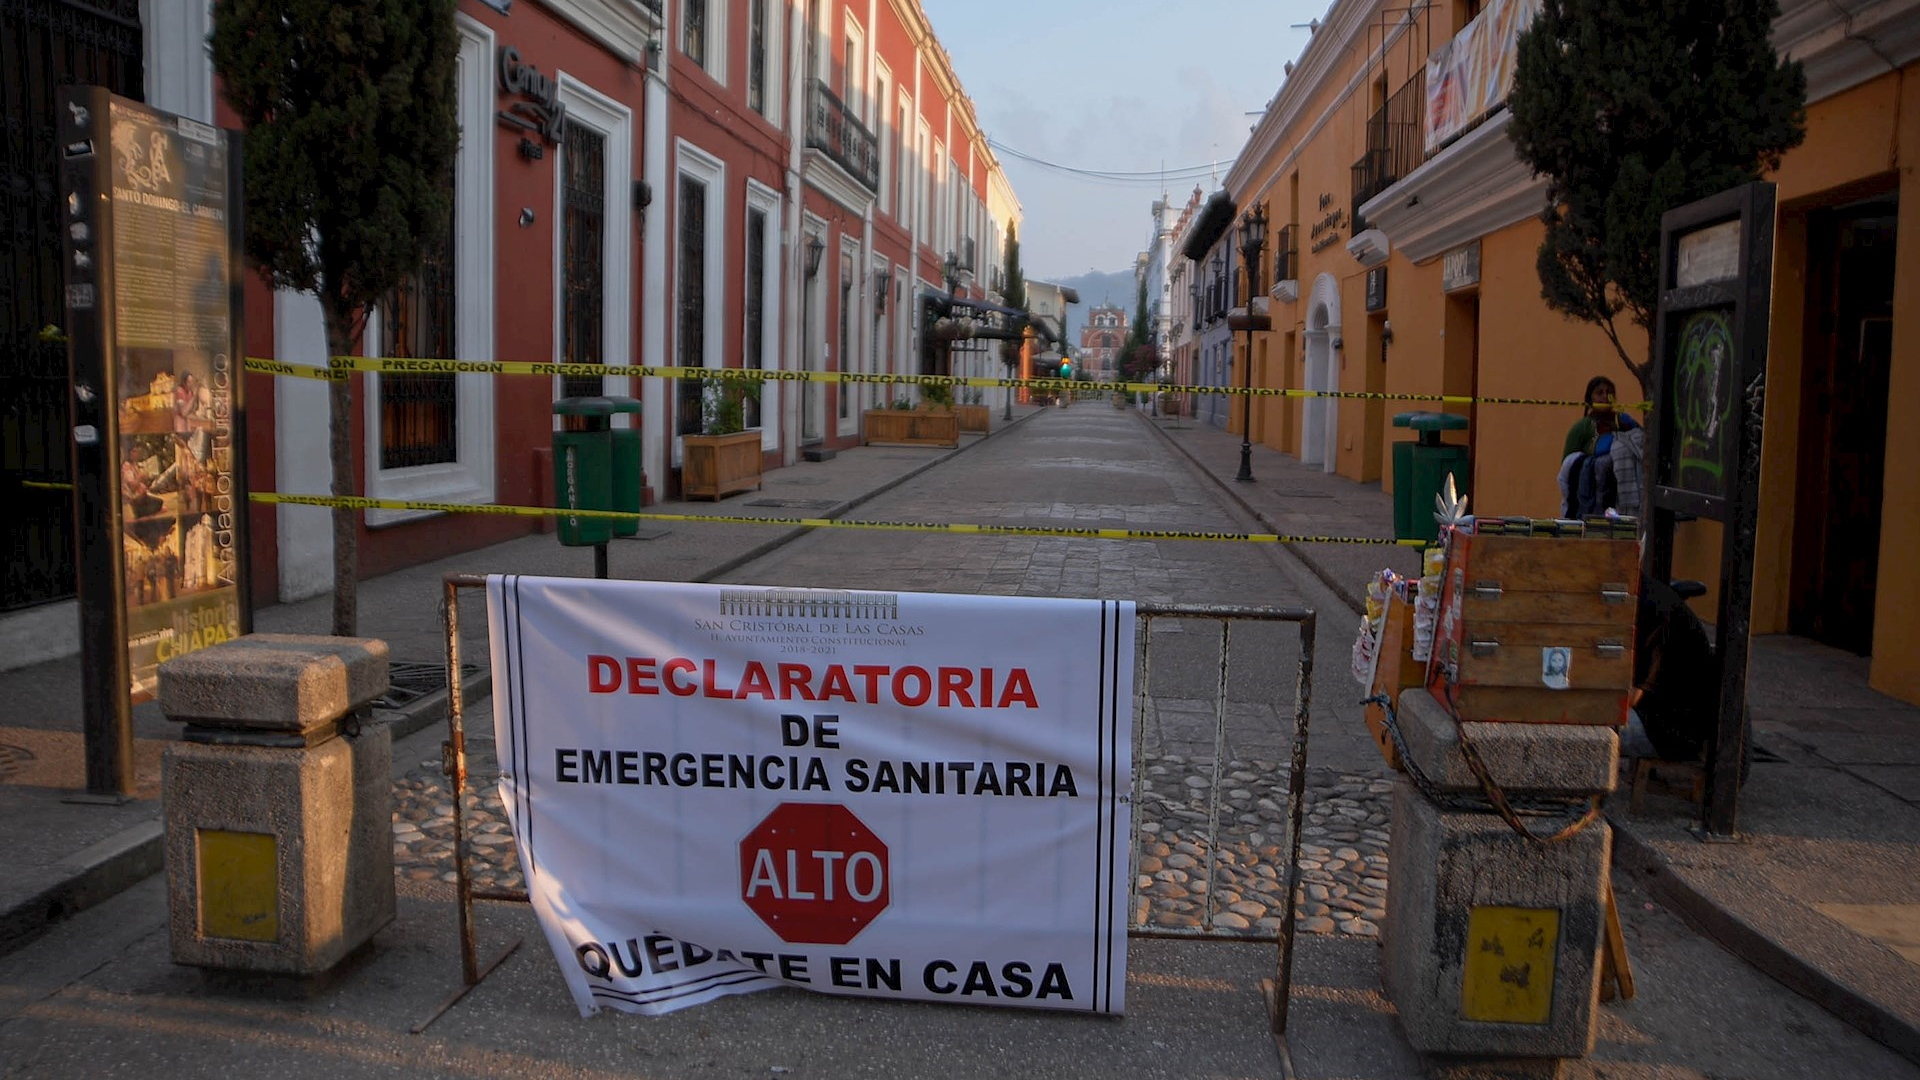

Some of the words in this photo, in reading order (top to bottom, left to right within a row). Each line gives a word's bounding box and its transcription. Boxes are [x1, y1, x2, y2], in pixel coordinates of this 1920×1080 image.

[113, 186, 141, 204] SANTO
[213, 468, 236, 585] Andador
[172, 599, 238, 633] historia
[694, 619, 724, 631] SAN
[729, 618, 813, 633] CRISTÓBAL
[818, 623, 839, 633] DE
[845, 622, 871, 634] LAS
[876, 623, 925, 636] CASAS
[156, 620, 238, 663] CHIAPAS
[725, 634, 809, 643] AYUNTAMIENTO
[811, 635, 907, 646] CONSTITUCIONAL
[780, 645, 837, 654] 2018-2021
[586, 654, 1040, 709] DECLARATORIA
[780, 713, 841, 750] DE
[555, 748, 831, 793] EMERGENCIA
[844, 757, 1079, 798] SANITARIA
[745, 848, 884, 903] ALTO
[828, 955, 902, 991] EN
[923, 958, 1075, 1001] CASA
